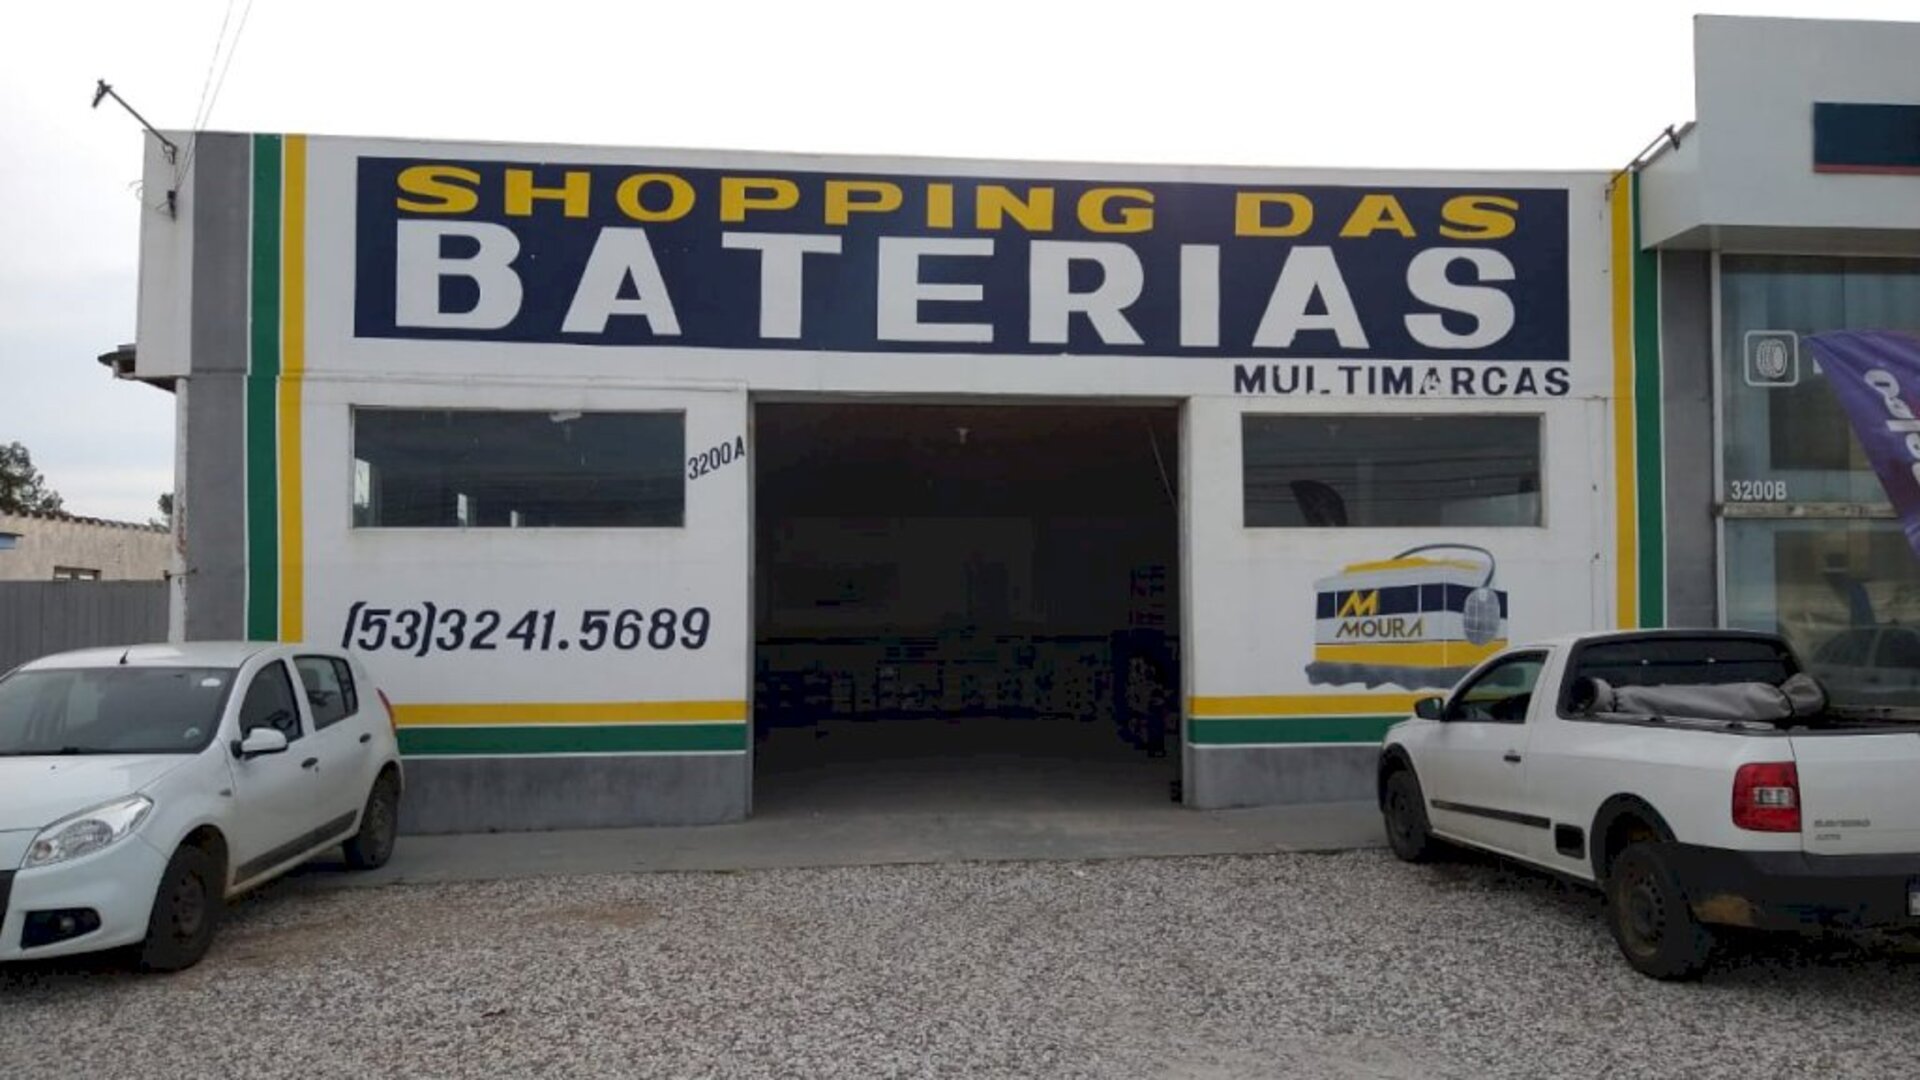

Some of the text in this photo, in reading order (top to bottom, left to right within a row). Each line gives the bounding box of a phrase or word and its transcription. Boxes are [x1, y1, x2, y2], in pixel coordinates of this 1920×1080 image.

[396, 165, 1519, 239] SHOPPING DAS
[395, 219, 1516, 350] BATERIAS
[1234, 364, 1571, 397] MULTIMARCAS
[1731, 480, 1787, 500] 3200B
[341, 600, 711, 657] (53)3241.5689
[1336, 616, 1424, 638] MOURA
